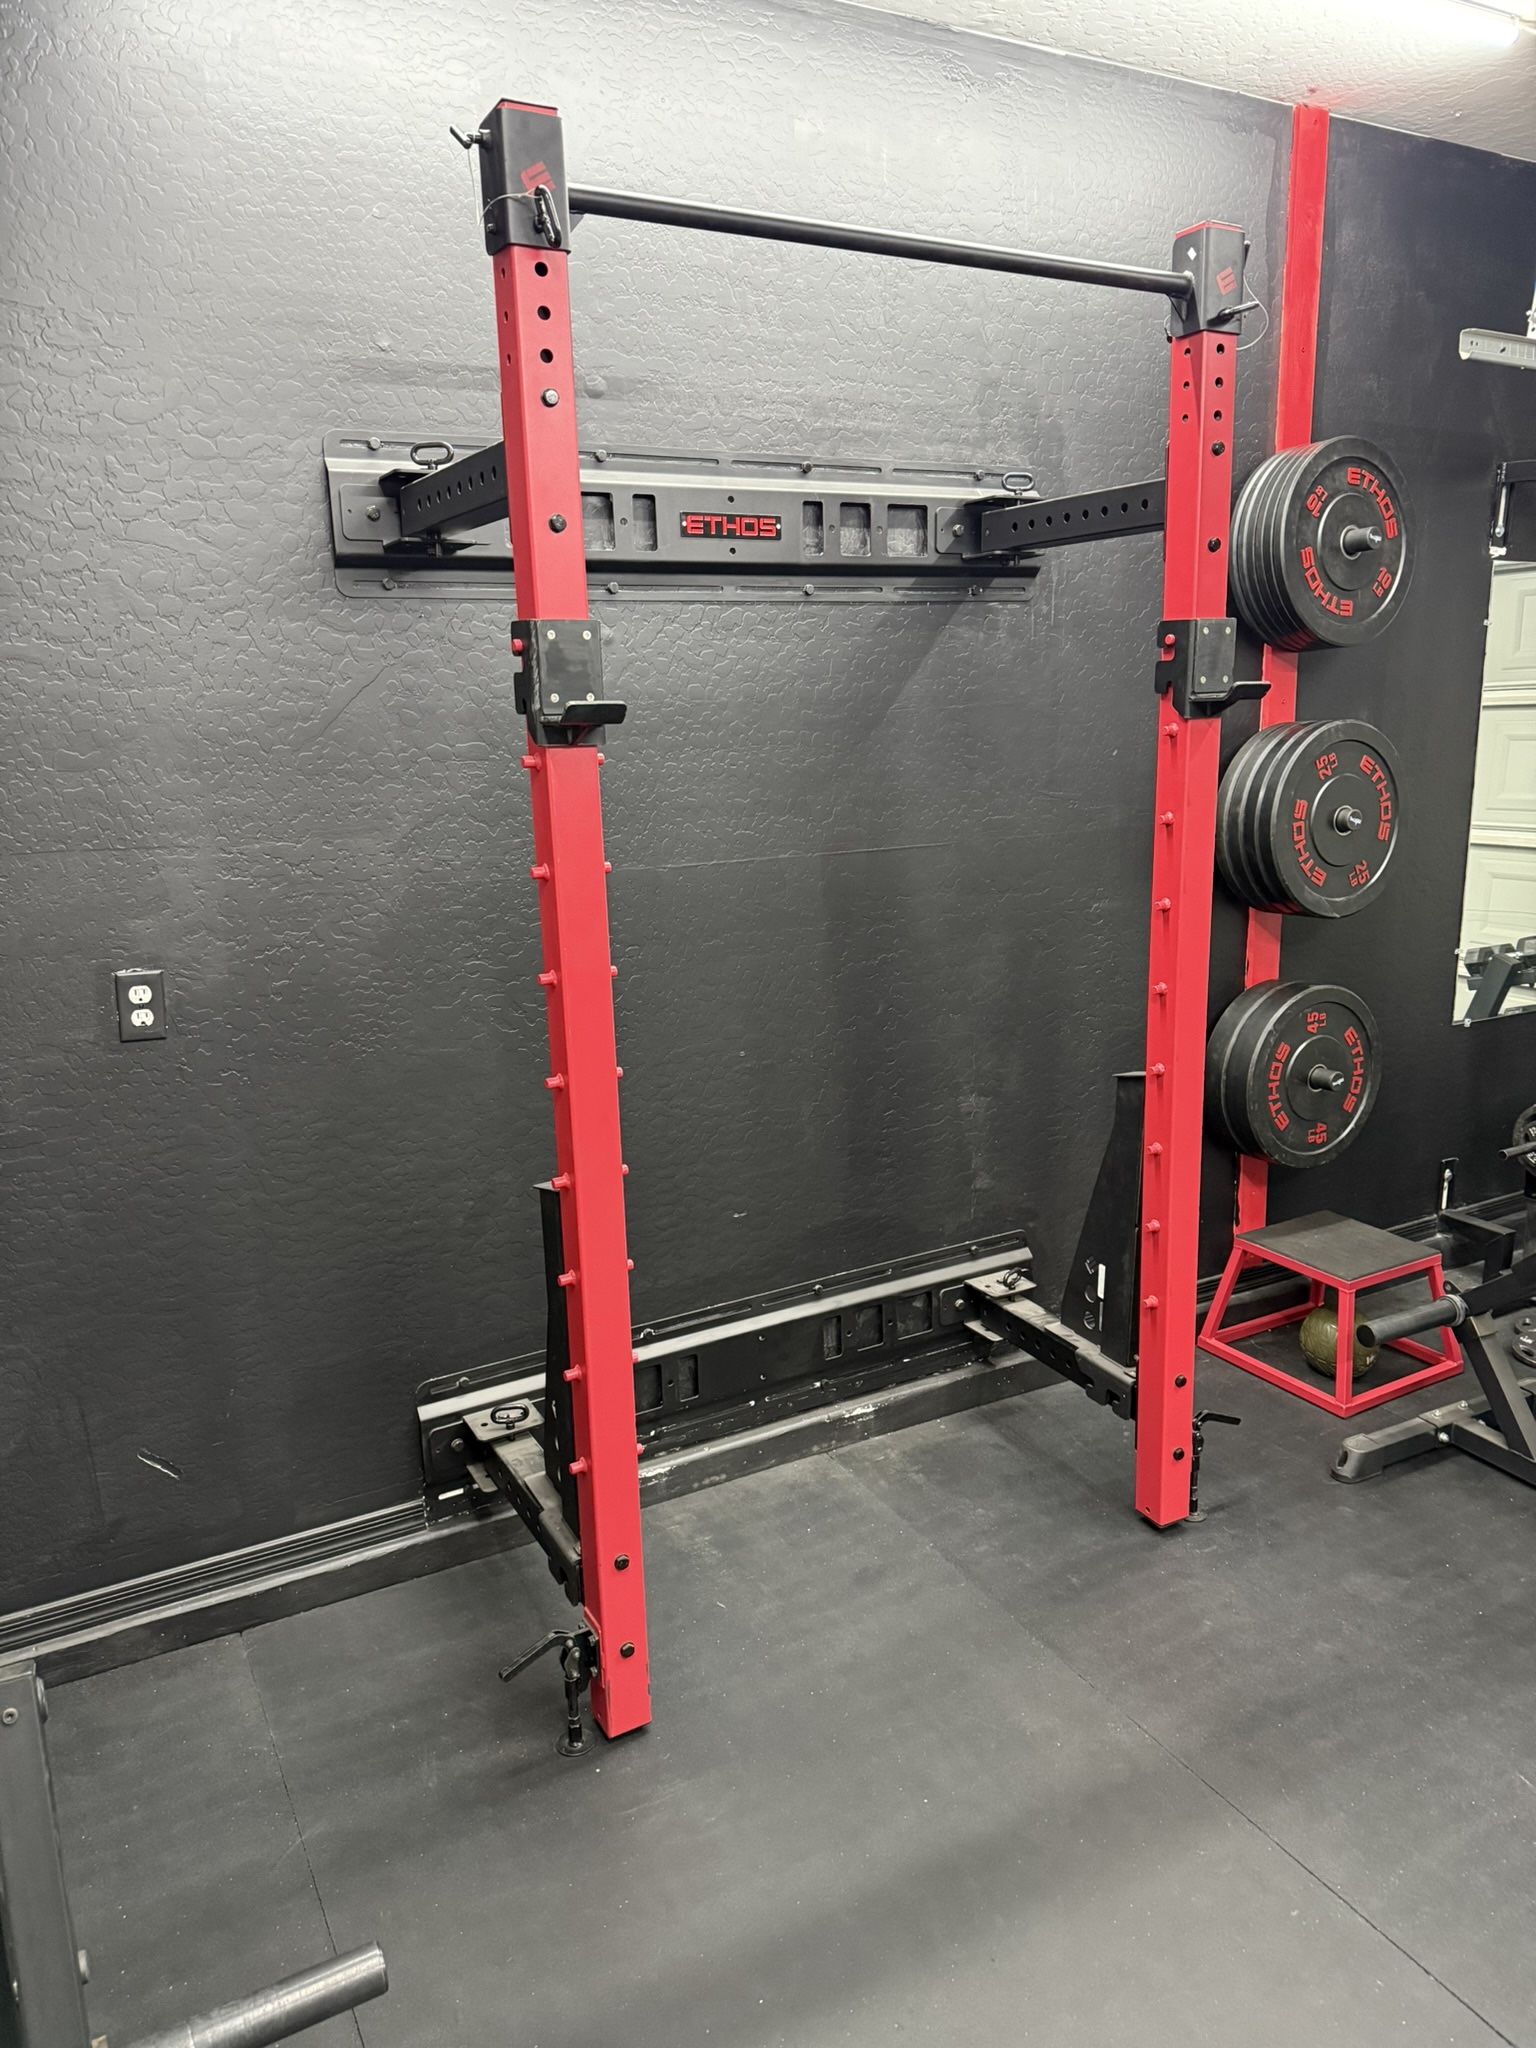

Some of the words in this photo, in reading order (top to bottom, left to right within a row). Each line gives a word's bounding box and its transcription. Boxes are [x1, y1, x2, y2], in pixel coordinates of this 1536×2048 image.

[1306, 493, 1324, 518] 10
[1347, 467, 1398, 539] ETHOS
[686, 515, 777, 536] ETHOS
[1300, 546, 1354, 617] ETHOS
[1376, 567, 1392, 590] 10
[1315, 755, 1333, 780] 25
[1328, 752, 1339, 769] LB
[1359, 754, 1392, 842] ETHOS
[1292, 799, 1328, 887] ETHOS
[1354, 860, 1370, 884] 25
[1306, 1011, 1319, 1034] 45
[1342, 1026, 1365, 1113] ETHOS
[1267, 1041, 1291, 1132] ETHOS
[1315, 1122, 1328, 1145] 45
